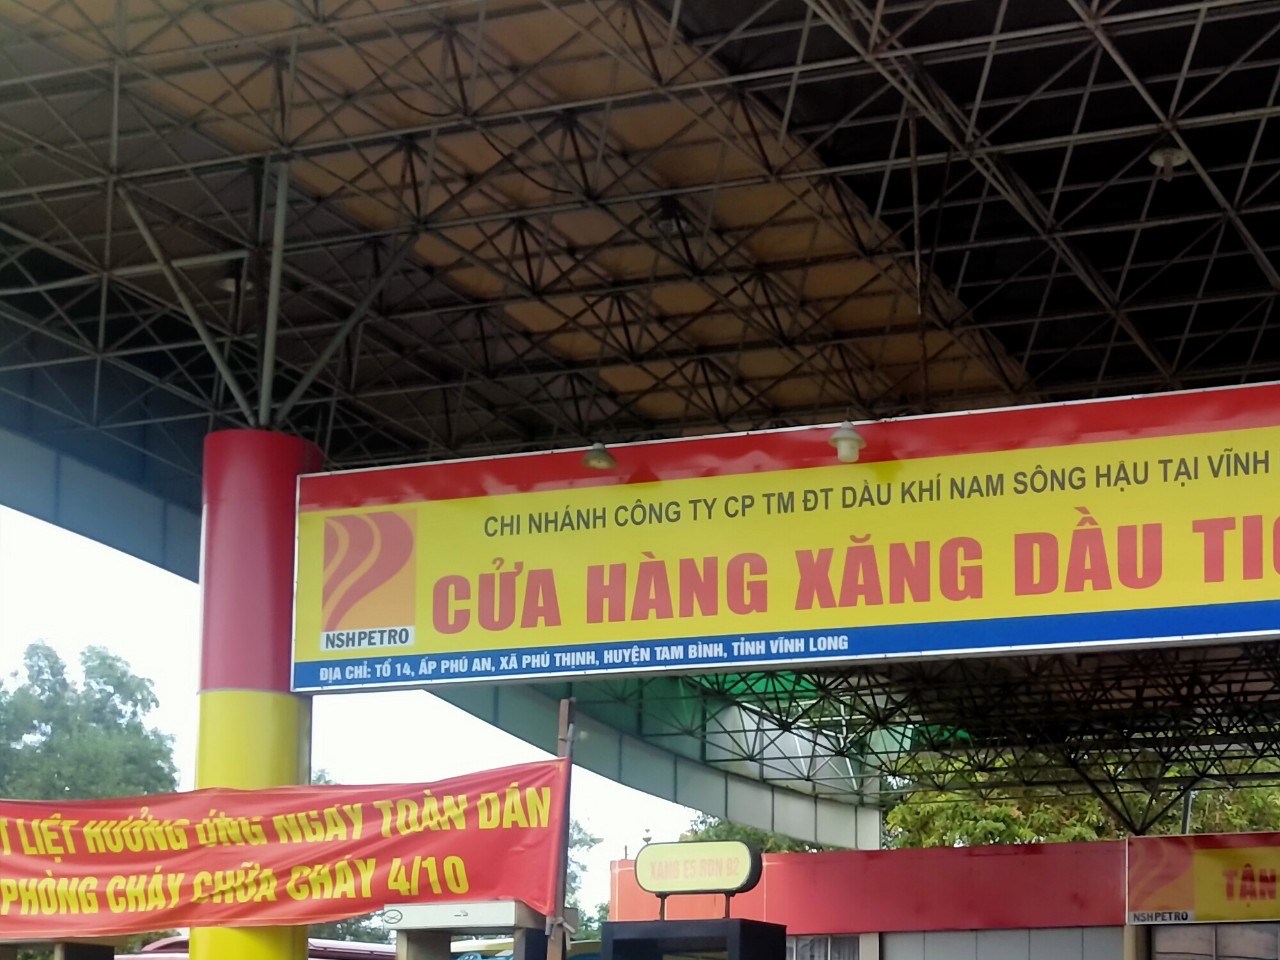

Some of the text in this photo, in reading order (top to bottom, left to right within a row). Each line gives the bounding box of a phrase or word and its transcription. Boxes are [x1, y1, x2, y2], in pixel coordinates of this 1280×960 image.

[483, 515, 521, 538] CHI
[528, 502, 607, 534] NHÁNH
[614, 499, 681, 527] CÔNG
[688, 498, 717, 521] TY
[724, 494, 754, 519] CP
[762, 491, 795, 515] TM
[802, 487, 834, 512] ĐT
[842, 479, 891, 509] DẦU
[901, 474, 941, 504] KHÍ
[949, 473, 1004, 500] NAM
[1013, 465, 1086, 496] SÔNG
[1095, 460, 1149, 494] HẬU
[1158, 456, 1199, 488] TẠI
[1207, 448, 1270, 478] VĨNH
[432, 557, 561, 634] CỬA
[587, 551, 768, 624] HÀNG
[795, 533, 983, 610] XĂNG
[1014, 506, 1163, 596] DẦU
[320, 636, 848, 683] ĐỊA CHỈ: TỔ 14, ẤP PHÚ AN, XÃ PHÚ THỊNH, HUYỆN TAM BÌNH, TỈNH VĨNH LONG
[325, 628, 409, 649] NSHPETRO
[16, 813, 79, 863] LIỆT
[83, 806, 189, 853] HƯỞNG
[195, 809, 267, 847] ỨNG
[374, 789, 468, 838] TOÀN
[0, 855, 469, 915] PHÒNG CHÁY CHỮA CHÁY 4/10
[1133, 911, 1188, 922] NSHPETRO
